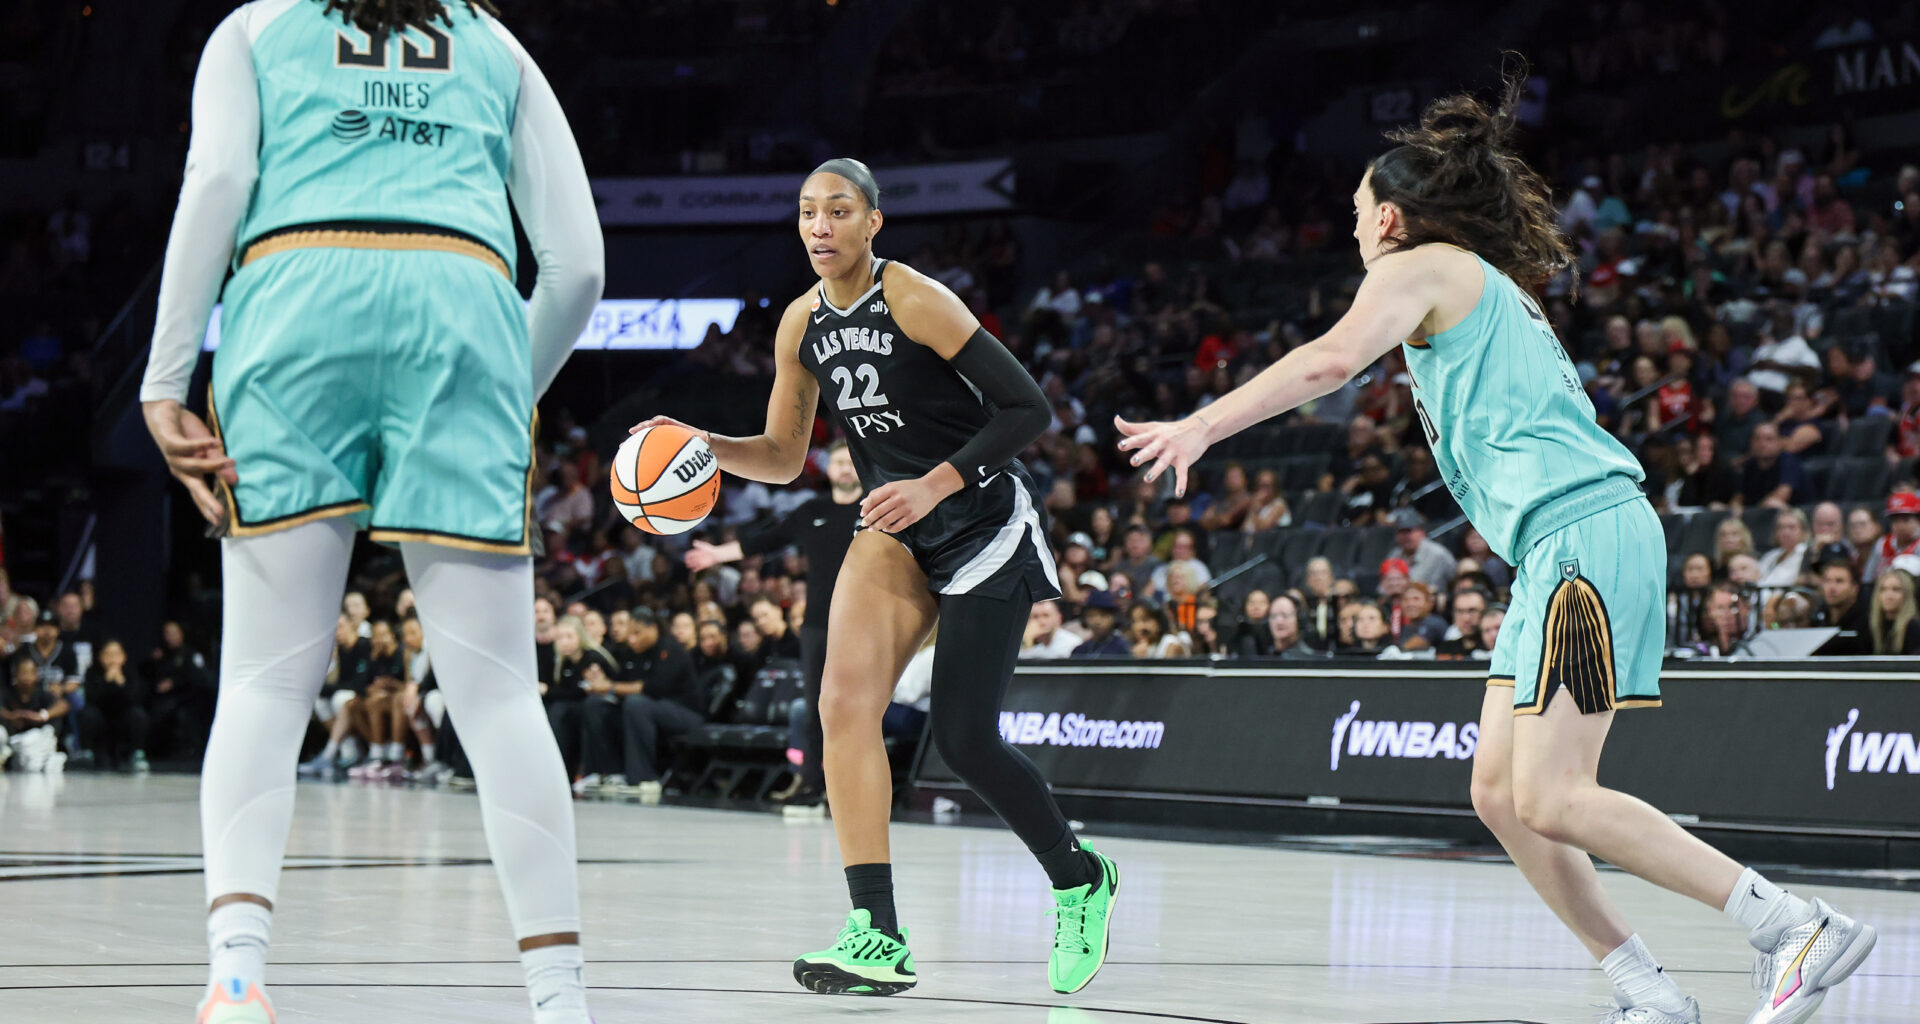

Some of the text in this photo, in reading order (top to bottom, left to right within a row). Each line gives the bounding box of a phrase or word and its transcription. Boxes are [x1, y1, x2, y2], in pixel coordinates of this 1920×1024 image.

[358, 80, 430, 109] JONES
[379, 116, 453, 147] AT&T
[593, 311, 685, 339] RENA
[812, 327, 894, 365] LAS VEGAS
[830, 363, 889, 411] 22
[845, 409, 906, 439] PSY
[673, 448, 714, 483] Wilso
[999, 712, 1165, 749] NBAStore.com
[1347, 720, 1480, 761] WNBAS
